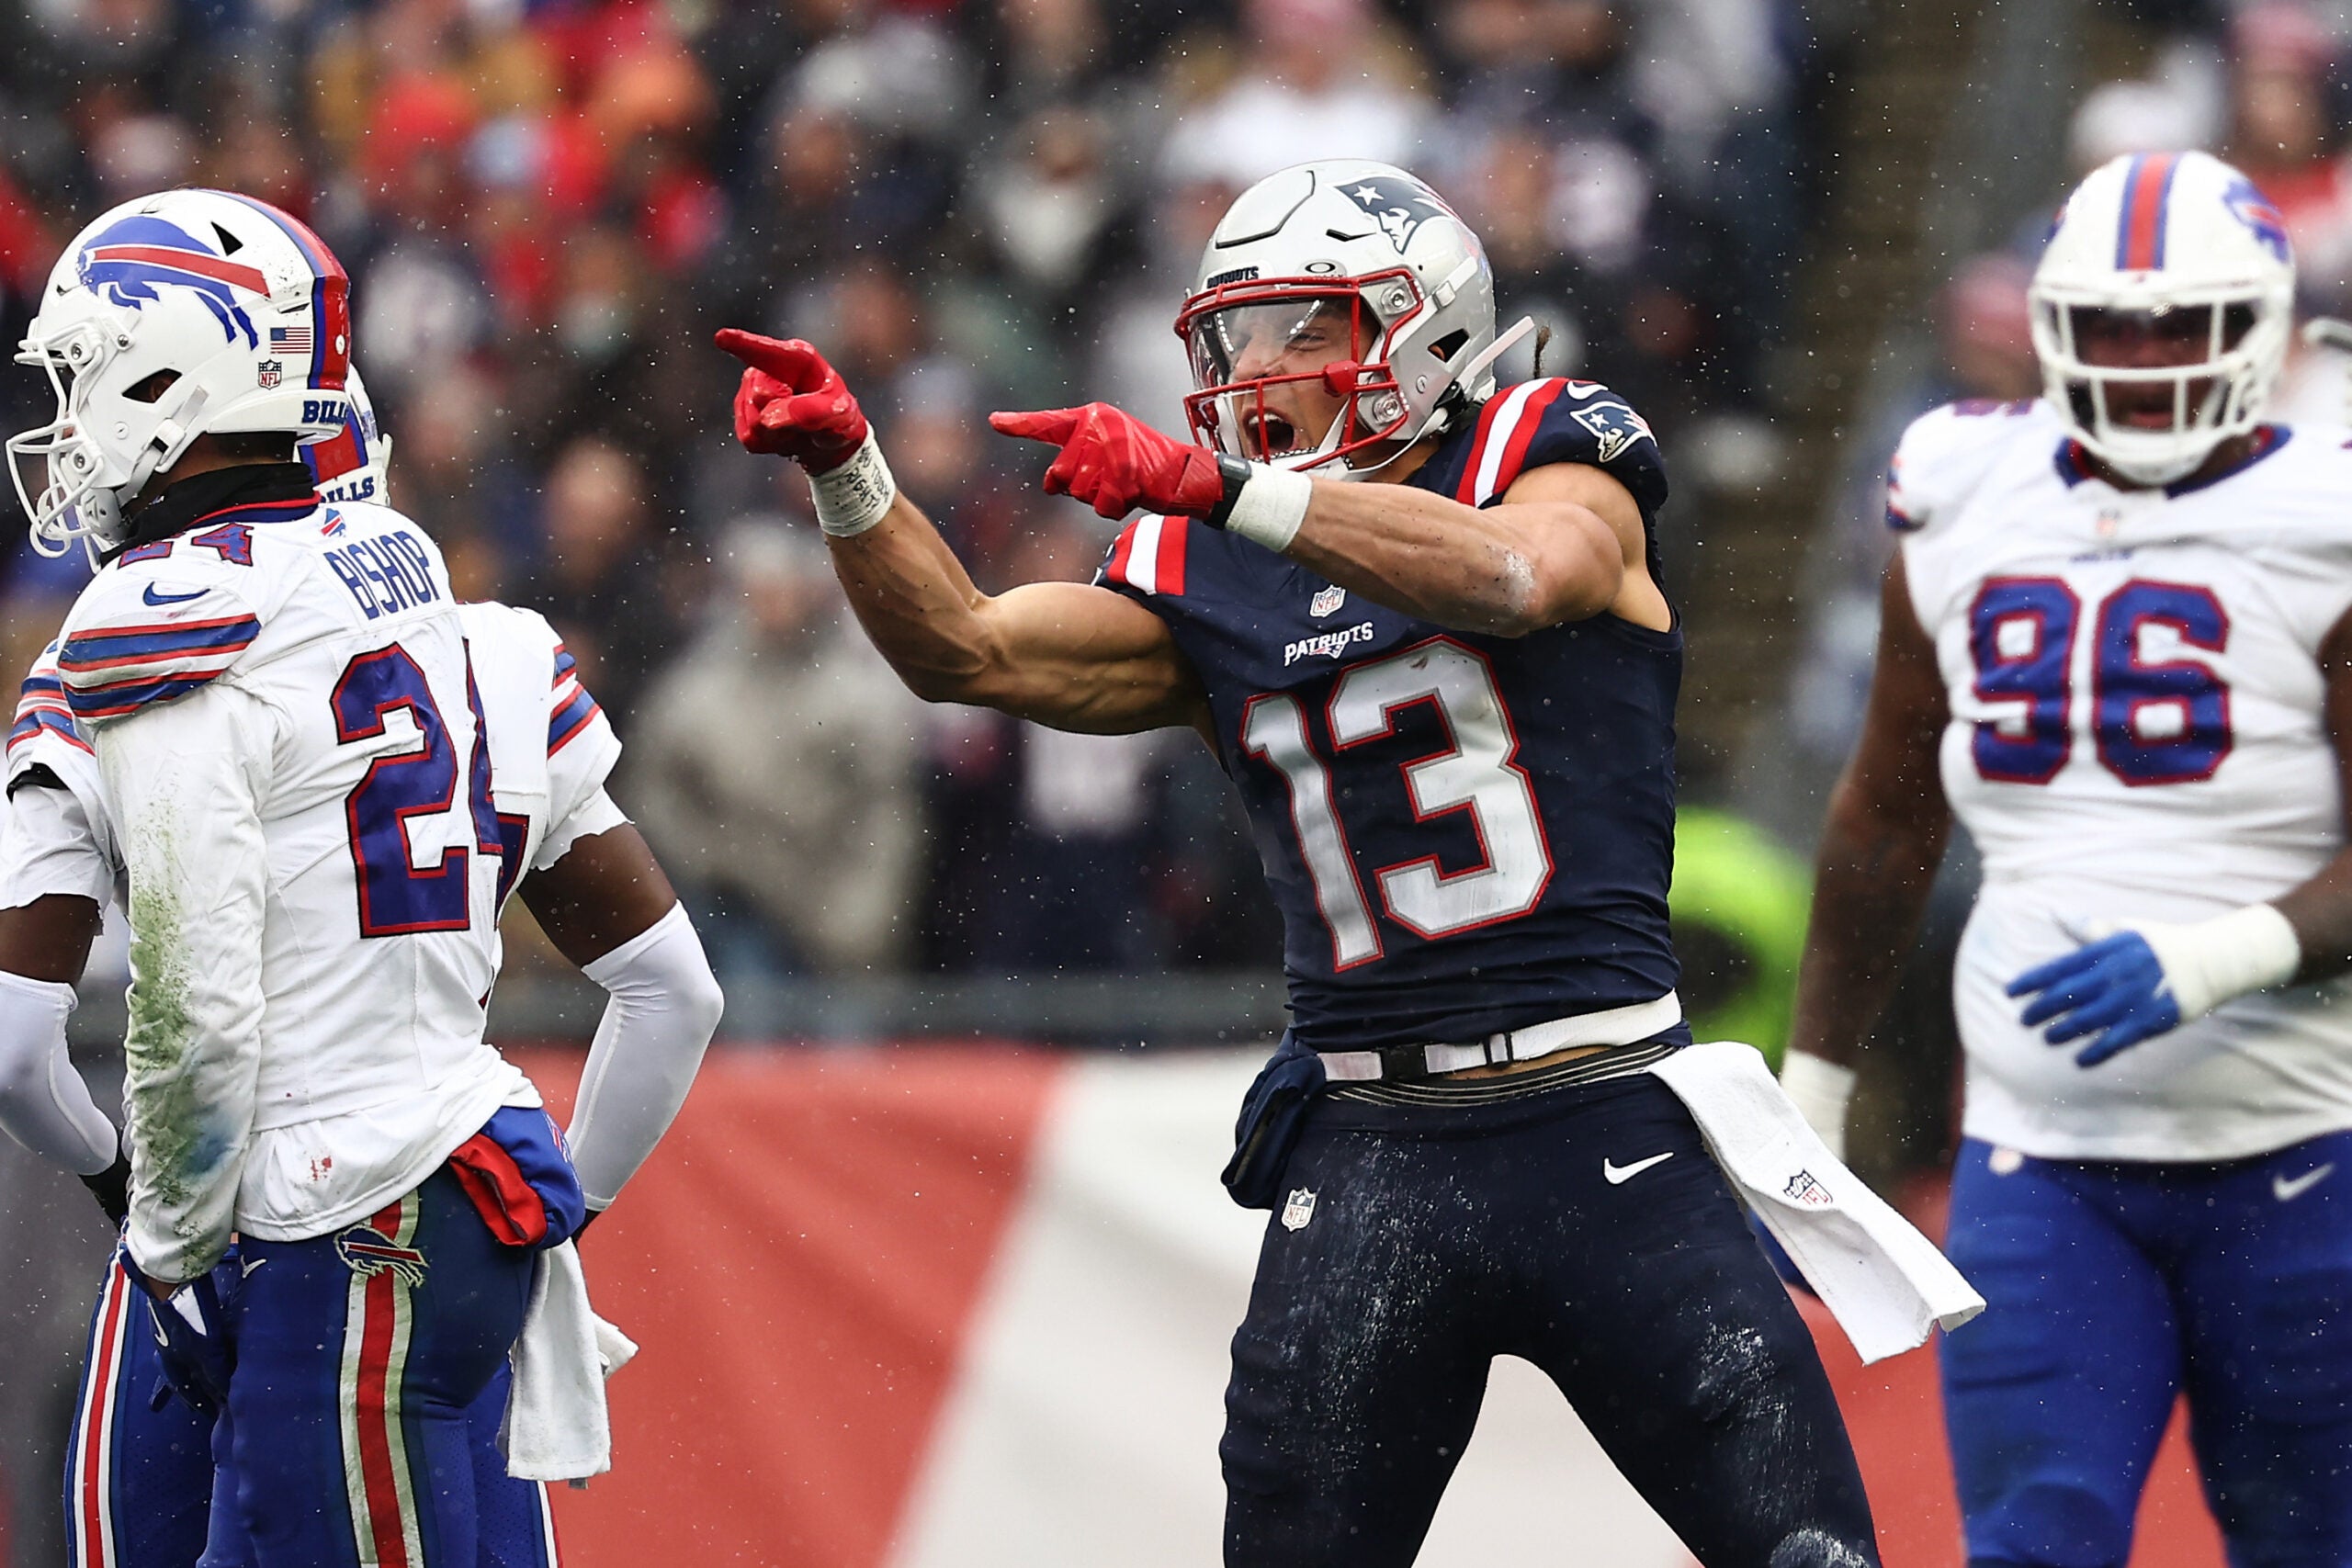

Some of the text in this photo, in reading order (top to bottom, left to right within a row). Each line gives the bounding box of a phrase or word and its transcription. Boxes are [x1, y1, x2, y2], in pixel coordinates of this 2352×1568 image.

[260, 372, 280, 386] NFL
[323, 531, 441, 620] BISHOP
[1284, 622, 1374, 667] PATRIOTS
[1967, 576, 2233, 788] 96
[1239, 633, 1555, 974] 13
